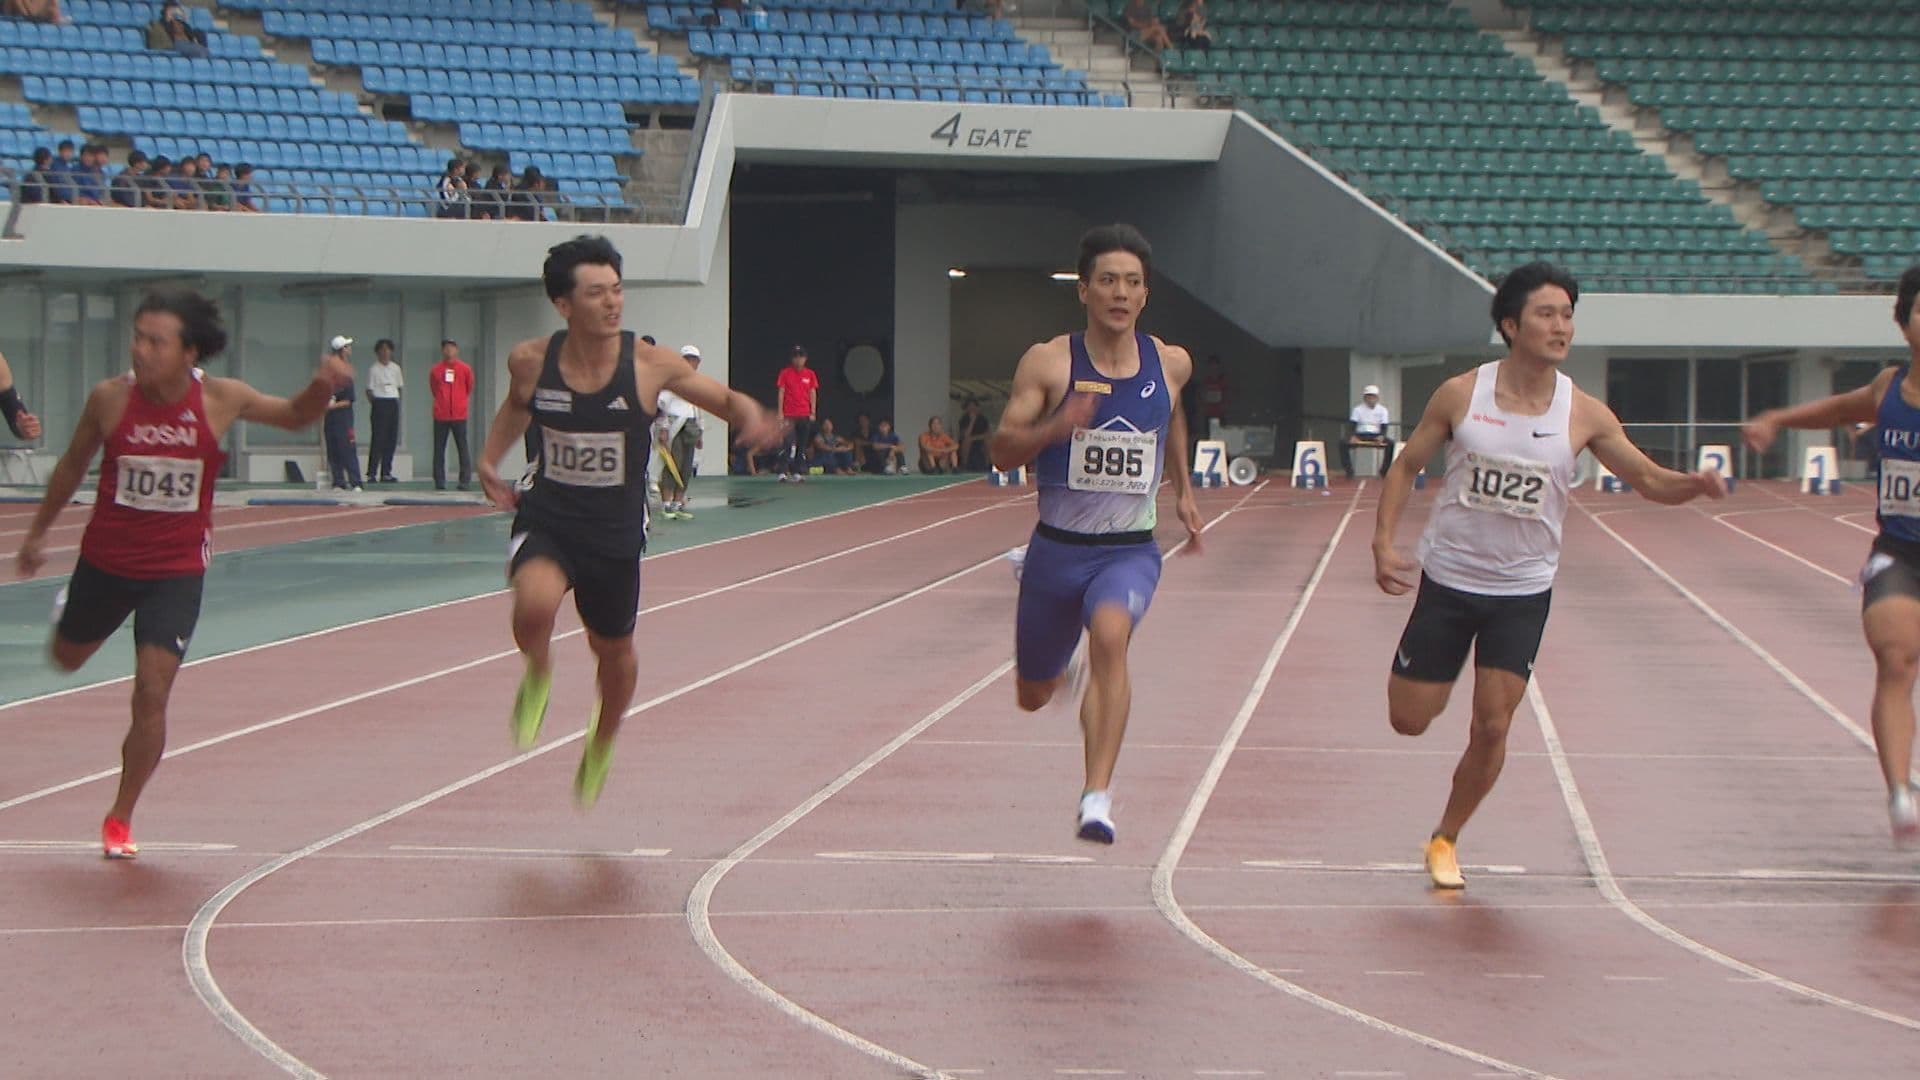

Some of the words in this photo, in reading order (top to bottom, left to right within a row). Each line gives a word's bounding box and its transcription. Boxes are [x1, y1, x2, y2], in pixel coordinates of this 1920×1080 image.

[931, 111, 962, 148] 4
[967, 128, 1033, 148] GATE
[127, 424, 198, 447] JOSAI
[551, 443, 616, 472] 1026
[1083, 445, 1143, 477] 995
[1201, 447, 1220, 479] 7
[1300, 447, 1320, 480] 6
[125, 467, 195, 498] 1043
[1469, 466, 1543, 504] 1022
